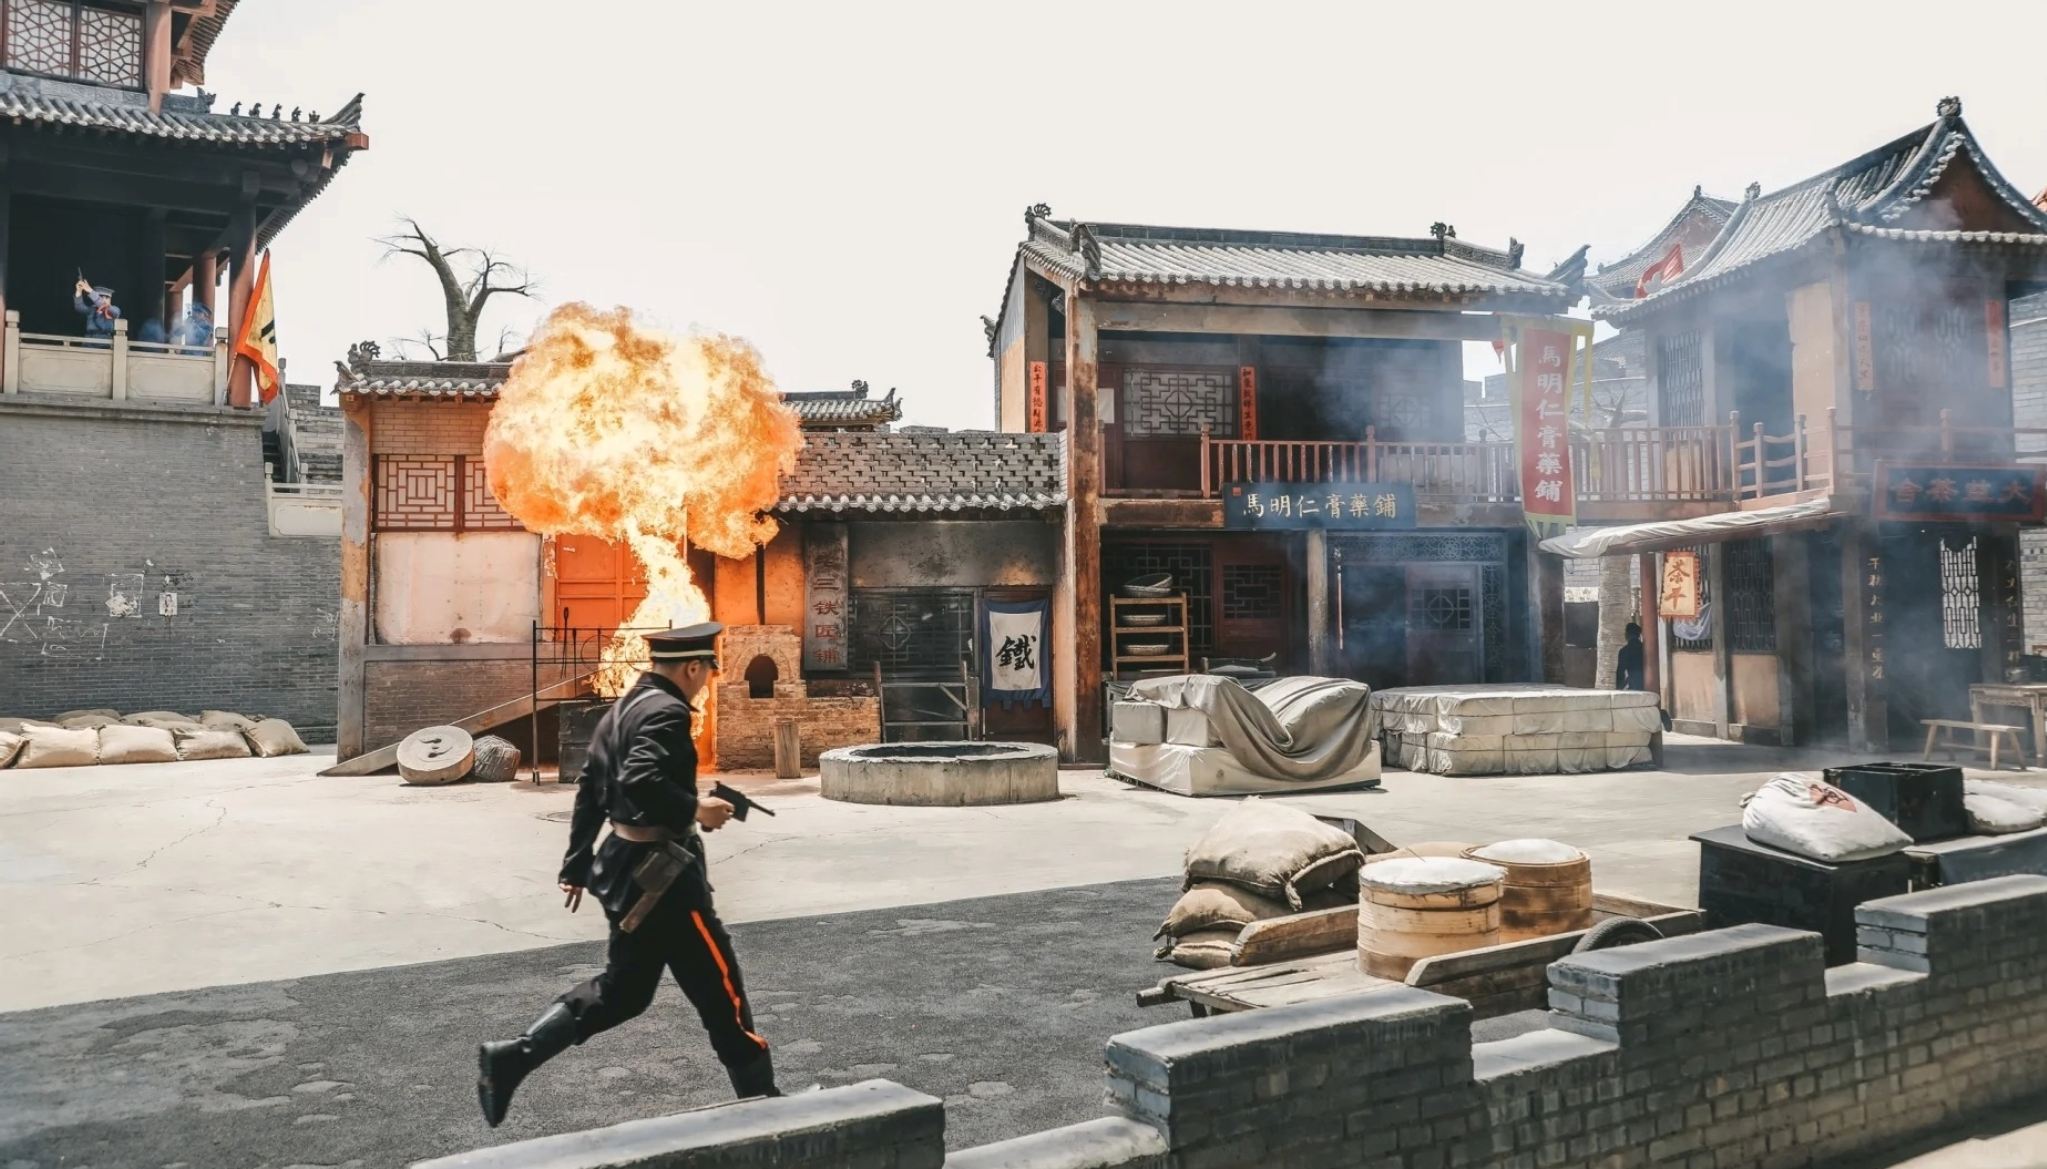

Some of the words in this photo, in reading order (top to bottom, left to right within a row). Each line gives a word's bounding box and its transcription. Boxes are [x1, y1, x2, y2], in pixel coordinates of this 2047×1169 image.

[1534, 345, 1564, 502] 馬明仁膏藥鋪
[1243, 493, 1397, 519] 馬明仁膏藥鋪
